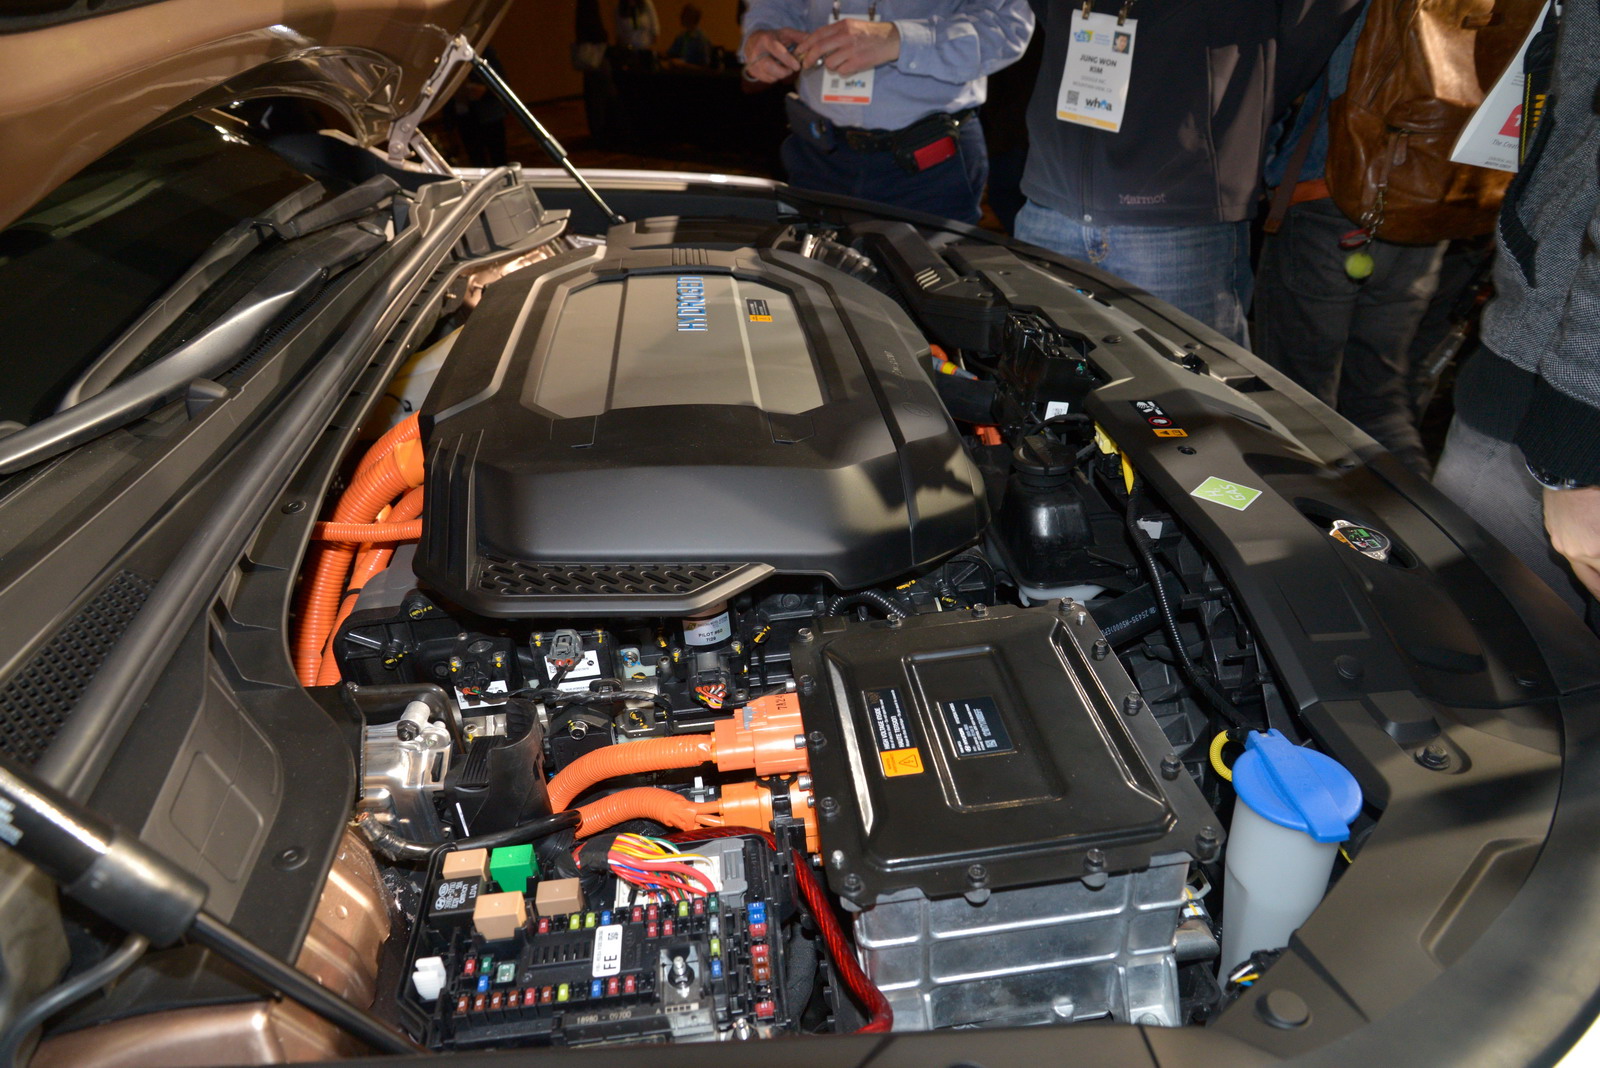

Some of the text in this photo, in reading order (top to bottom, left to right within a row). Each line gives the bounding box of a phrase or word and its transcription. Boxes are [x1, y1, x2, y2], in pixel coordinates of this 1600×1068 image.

[1080, 54, 1117, 67] JUNG WON
[1090, 66, 1103, 74] KIM
[1118, 193, 1167, 205] Marmot
[677, 275, 709, 332] HYDROGEN
[603, 954, 618, 970] FE
